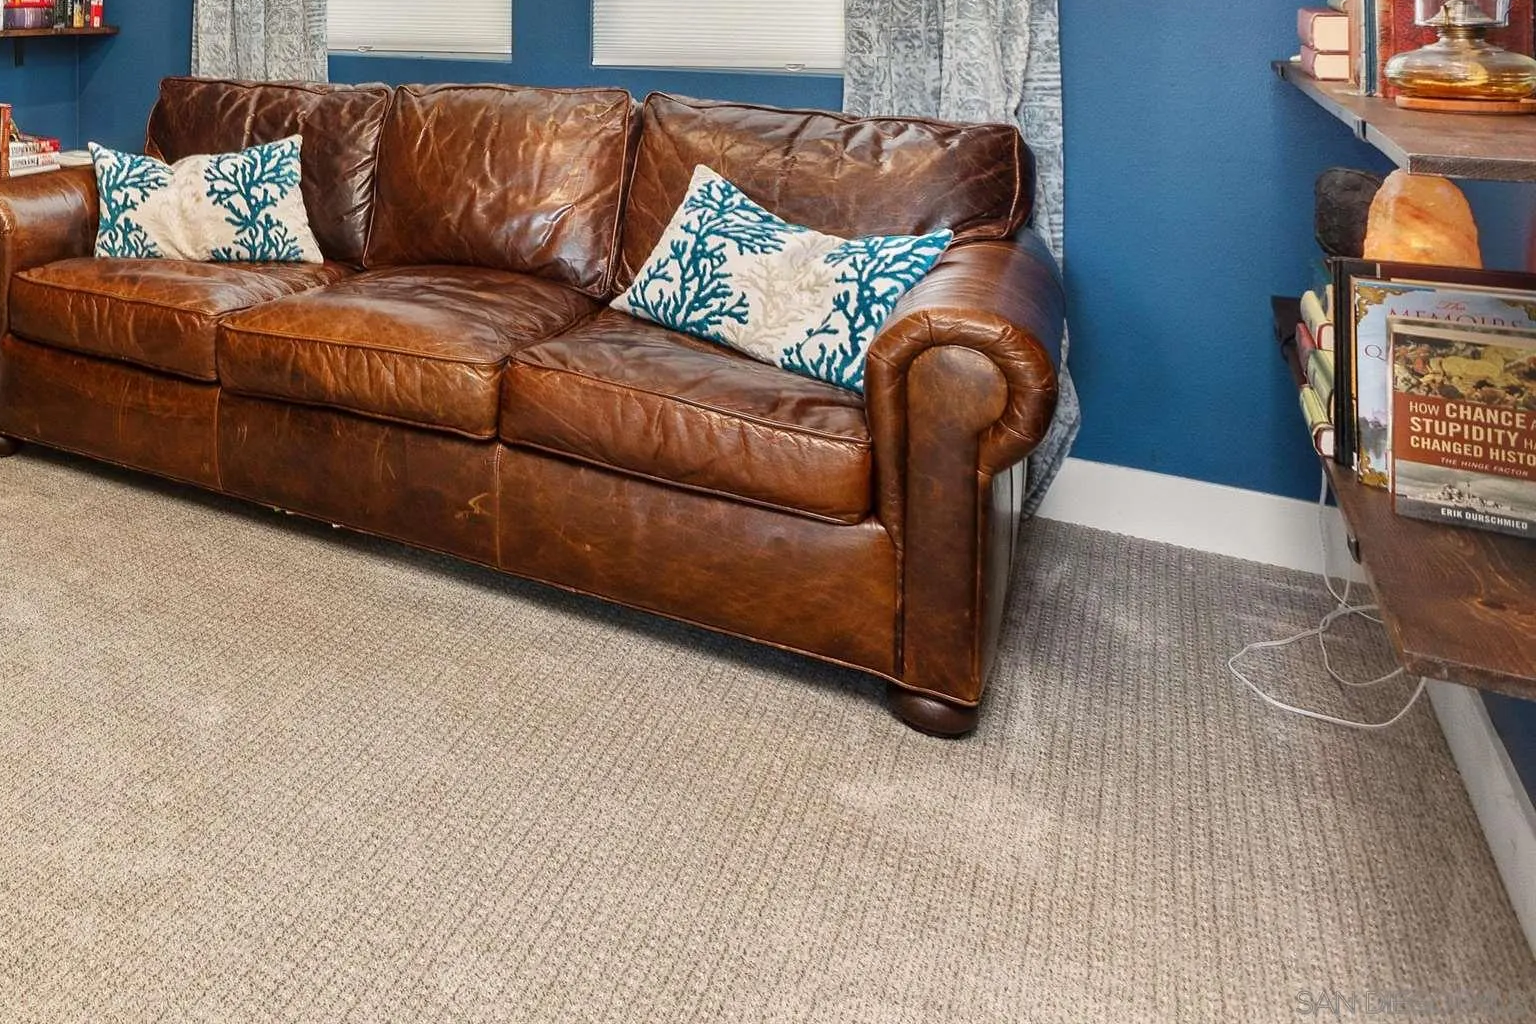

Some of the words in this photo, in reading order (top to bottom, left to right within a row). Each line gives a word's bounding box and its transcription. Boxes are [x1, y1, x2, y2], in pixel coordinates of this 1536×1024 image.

[1409, 401, 1440, 414] HOW
[1445, 402, 1526, 429] CHANCE
[1410, 416, 1520, 448] STUPIDITY
[1410, 436, 1484, 458] CHANGED
[1440, 456, 1458, 466] THE
[1461, 459, 1491, 471] HINGE
[1493, 465, 1528, 477] FACTOR
[1440, 508, 1462, 519] ERIK
[1465, 510, 1528, 530] DURSCHMIED
